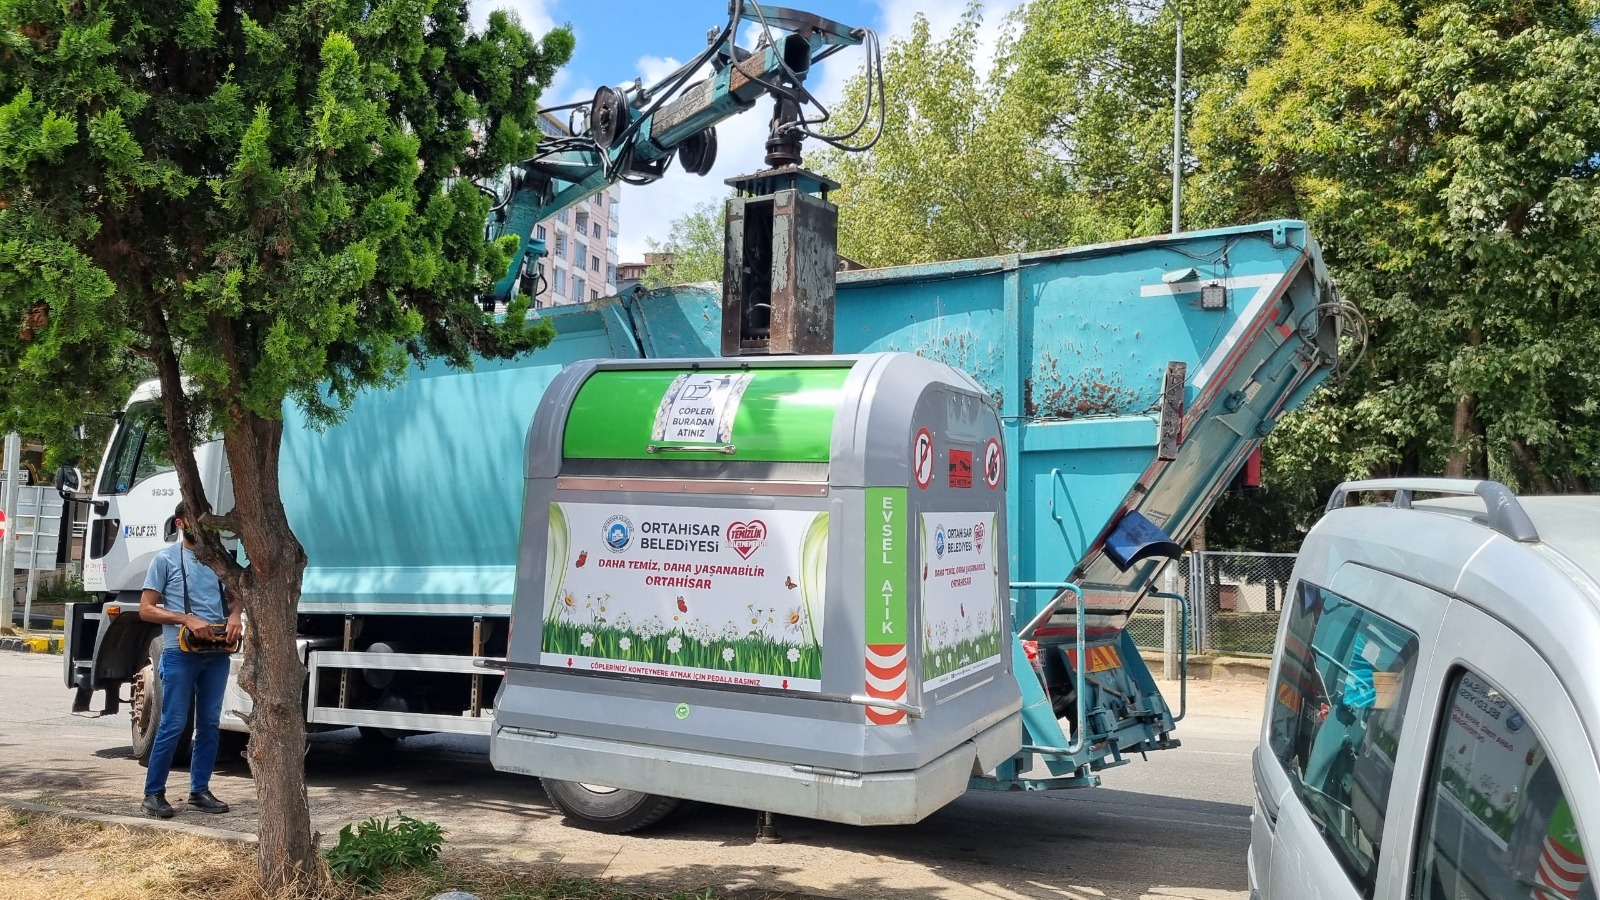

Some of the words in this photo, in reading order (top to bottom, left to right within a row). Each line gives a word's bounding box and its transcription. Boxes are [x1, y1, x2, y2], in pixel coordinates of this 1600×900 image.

[672, 417, 715, 426] BURADAN
[677, 428, 706, 437] ATINIZ
[129, 526, 135, 537] 34
[731, 526, 762, 540] TEMİZLİK
[881, 496, 893, 565] EVSEL
[598, 558, 626, 569] DAHA
[628, 558, 661, 573] TEMİZ,
[663, 562, 692, 573] DAHA
[693, 564, 765, 578] YAŞANABİLİR
[644, 574, 712, 590] ORTAHİSAR
[881, 579, 893, 635] ATIK
[590, 661, 628, 672] ÇÖPLERİNİZİ
[628, 666, 669, 677] KONTEYNERE
[669, 670, 692, 679] ATMAK
[692, 671, 706, 681] İÇİN
[706, 674, 733, 684] PEDALA
[733, 677, 761, 687] BASINIZ
